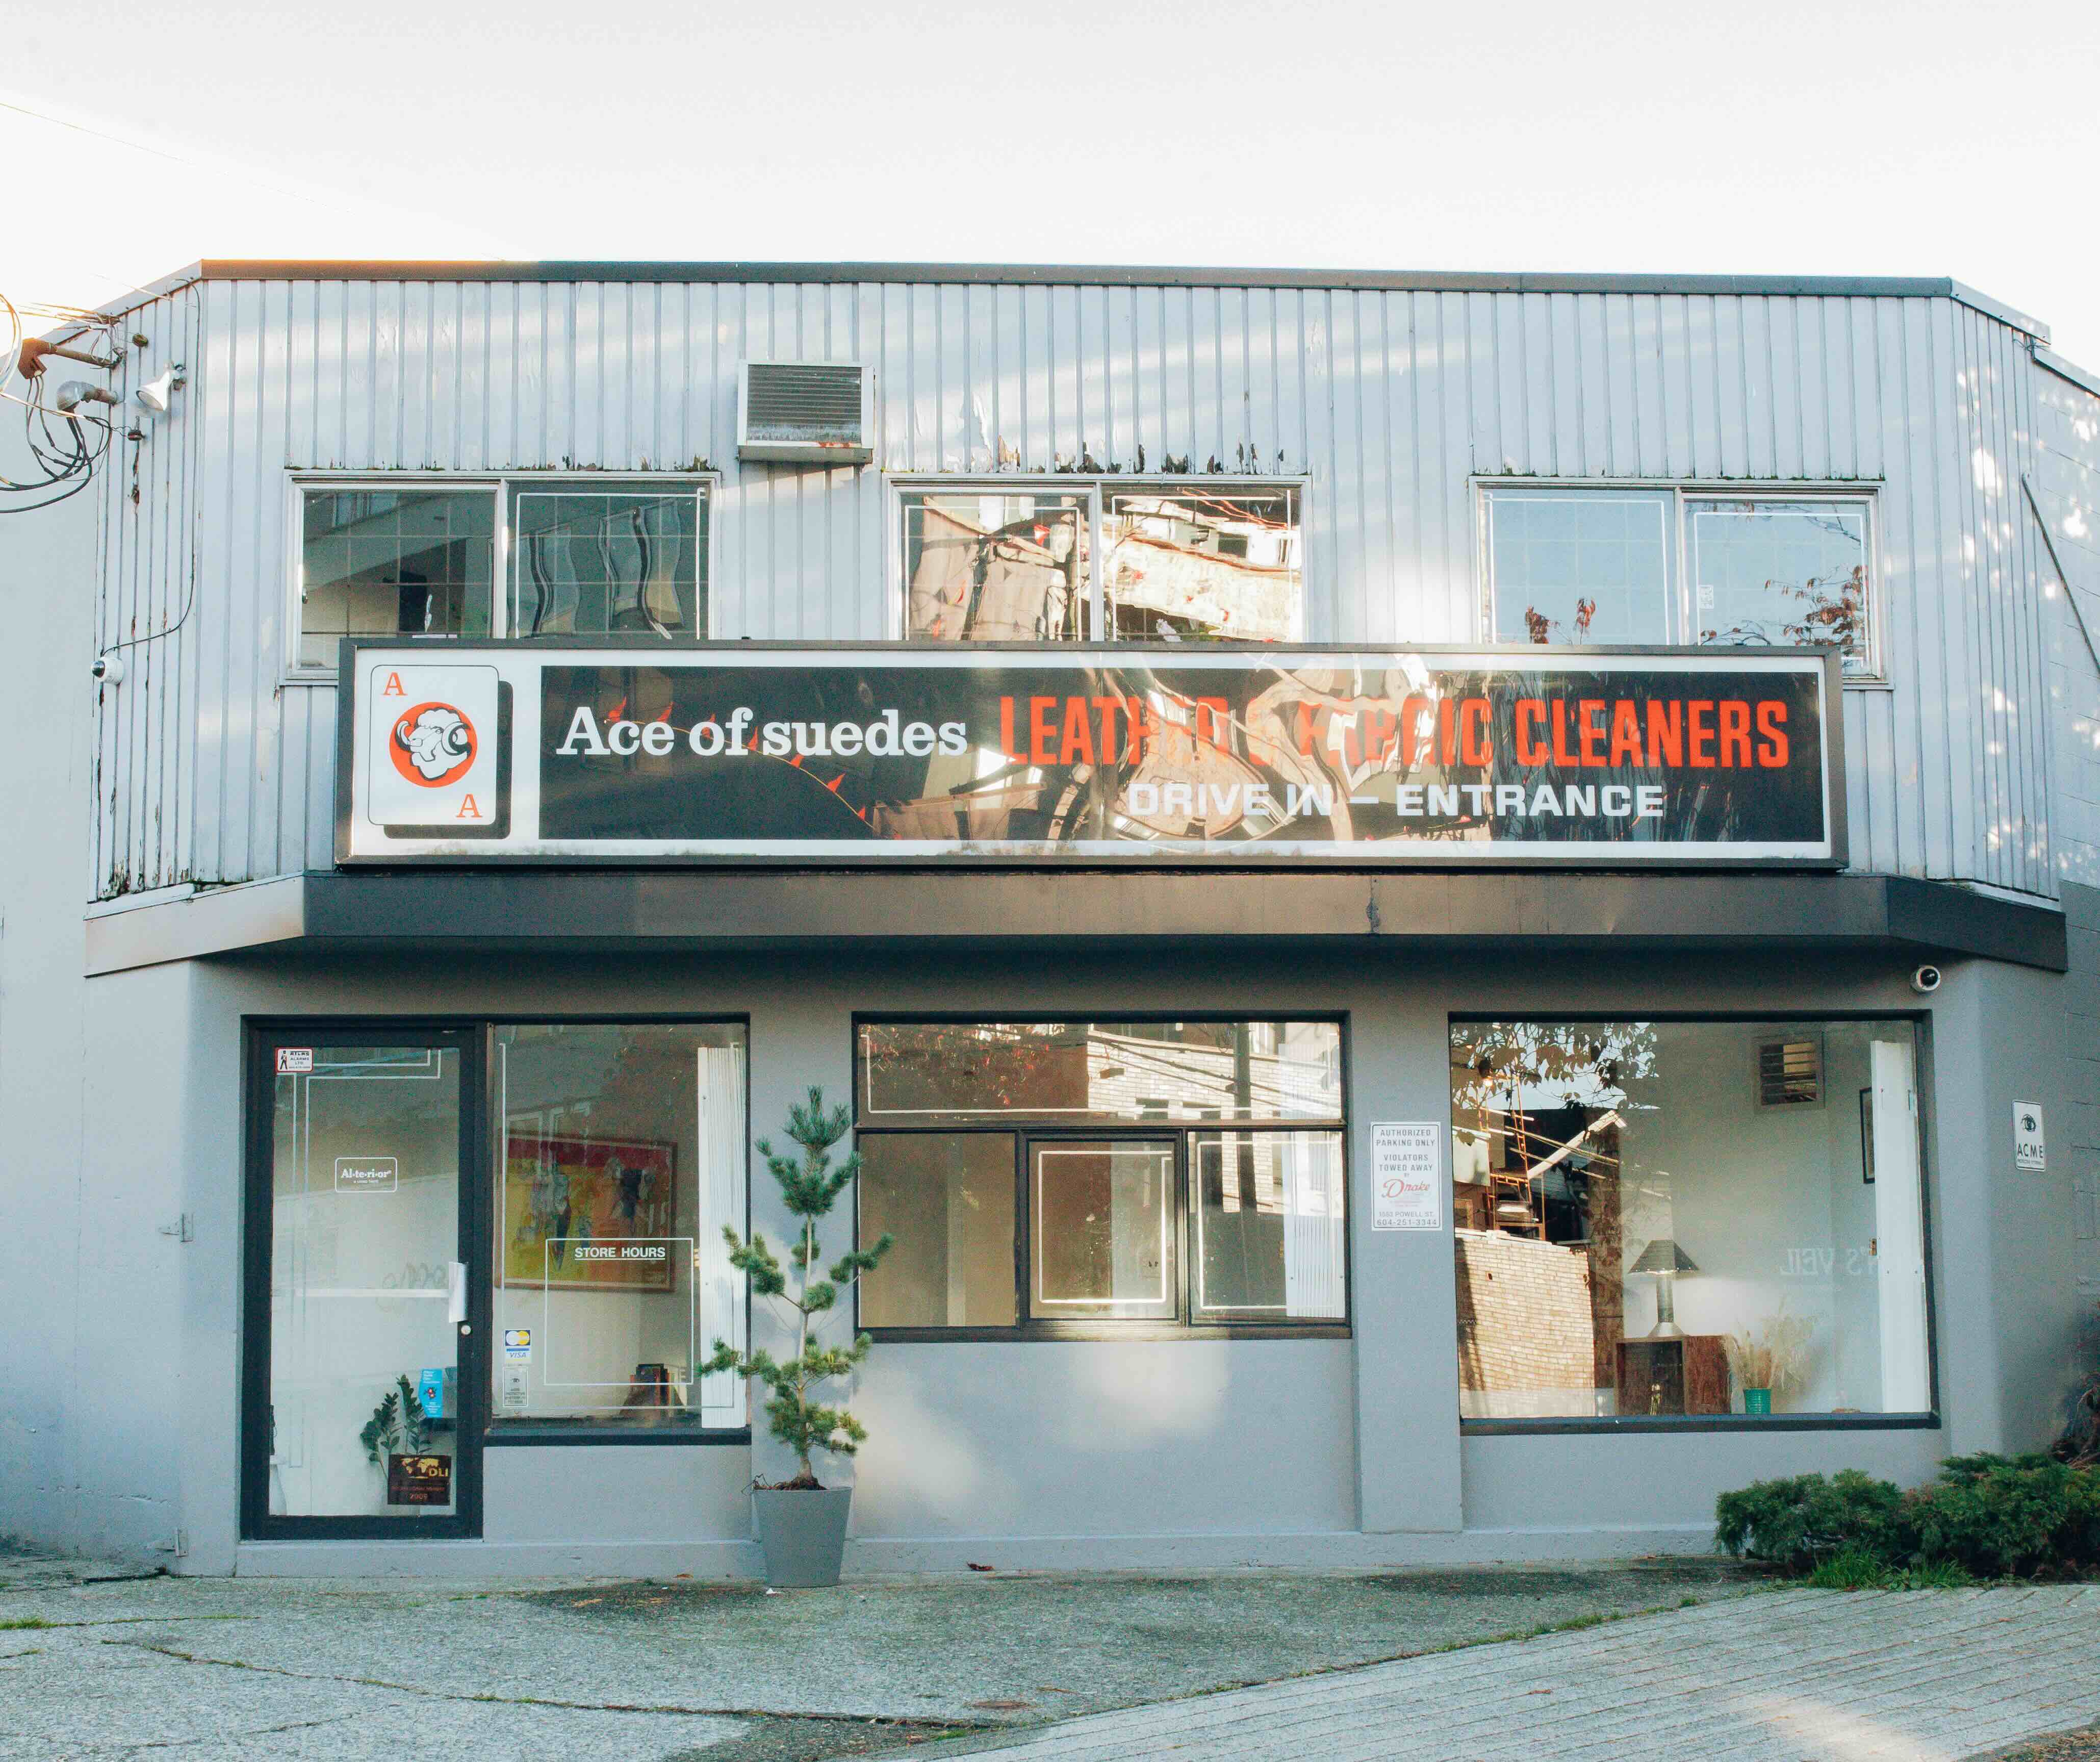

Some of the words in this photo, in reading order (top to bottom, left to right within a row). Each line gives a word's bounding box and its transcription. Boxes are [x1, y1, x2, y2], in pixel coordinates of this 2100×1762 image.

[382, 672, 408, 697] A
[555, 706, 675, 756] Ace
[689, 706, 752, 756] of
[762, 709, 968, 756] suedes
[1517, 698, 1788, 769] CLEANERS
[455, 793, 483, 819] A
[1127, 783, 1270, 816] DRIVE
[1287, 783, 1333, 817] IN
[1396, 784, 1664, 818] ENTRANCE
[2017, 1143, 2043, 1158] ACME
[575, 1247, 616, 1258] STORE
[621, 1247, 665, 1258] HOURS
[428, 1468, 449, 1477] DLI
